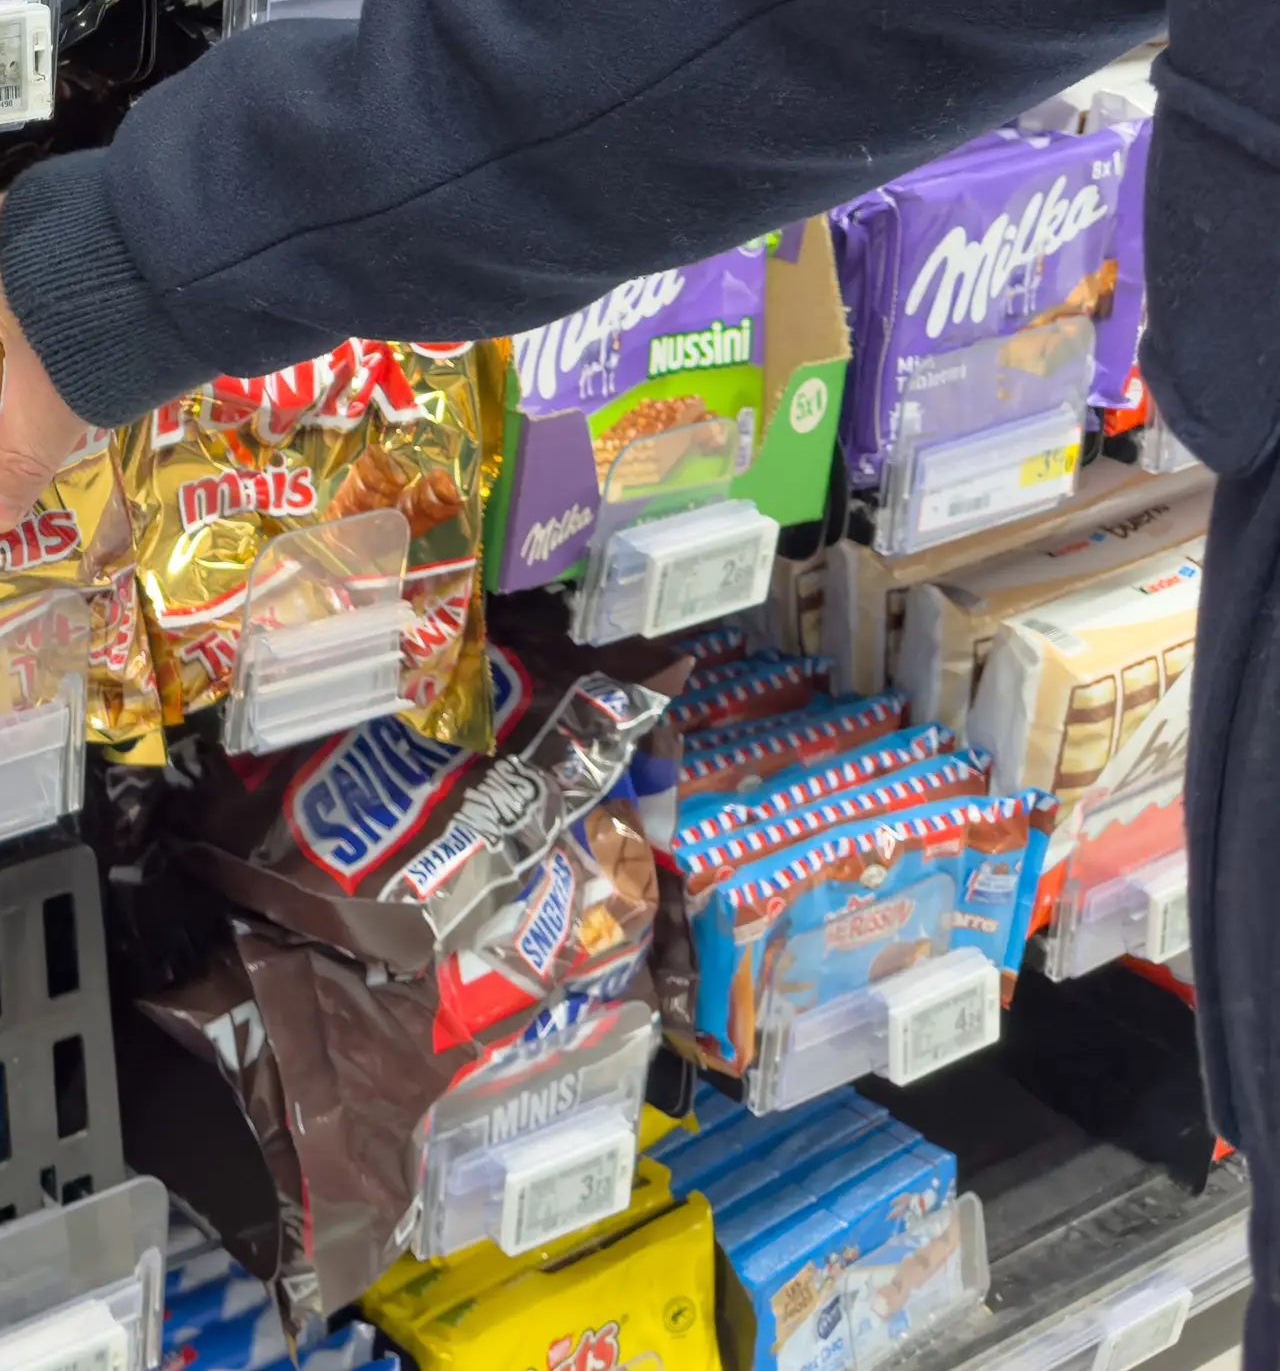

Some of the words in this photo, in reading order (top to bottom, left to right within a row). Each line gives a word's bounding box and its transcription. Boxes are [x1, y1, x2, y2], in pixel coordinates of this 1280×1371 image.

[906, 174, 1108, 338] Milka
[521, 504, 593, 566] Milka
[489, 1078, 581, 1145] MINIS
